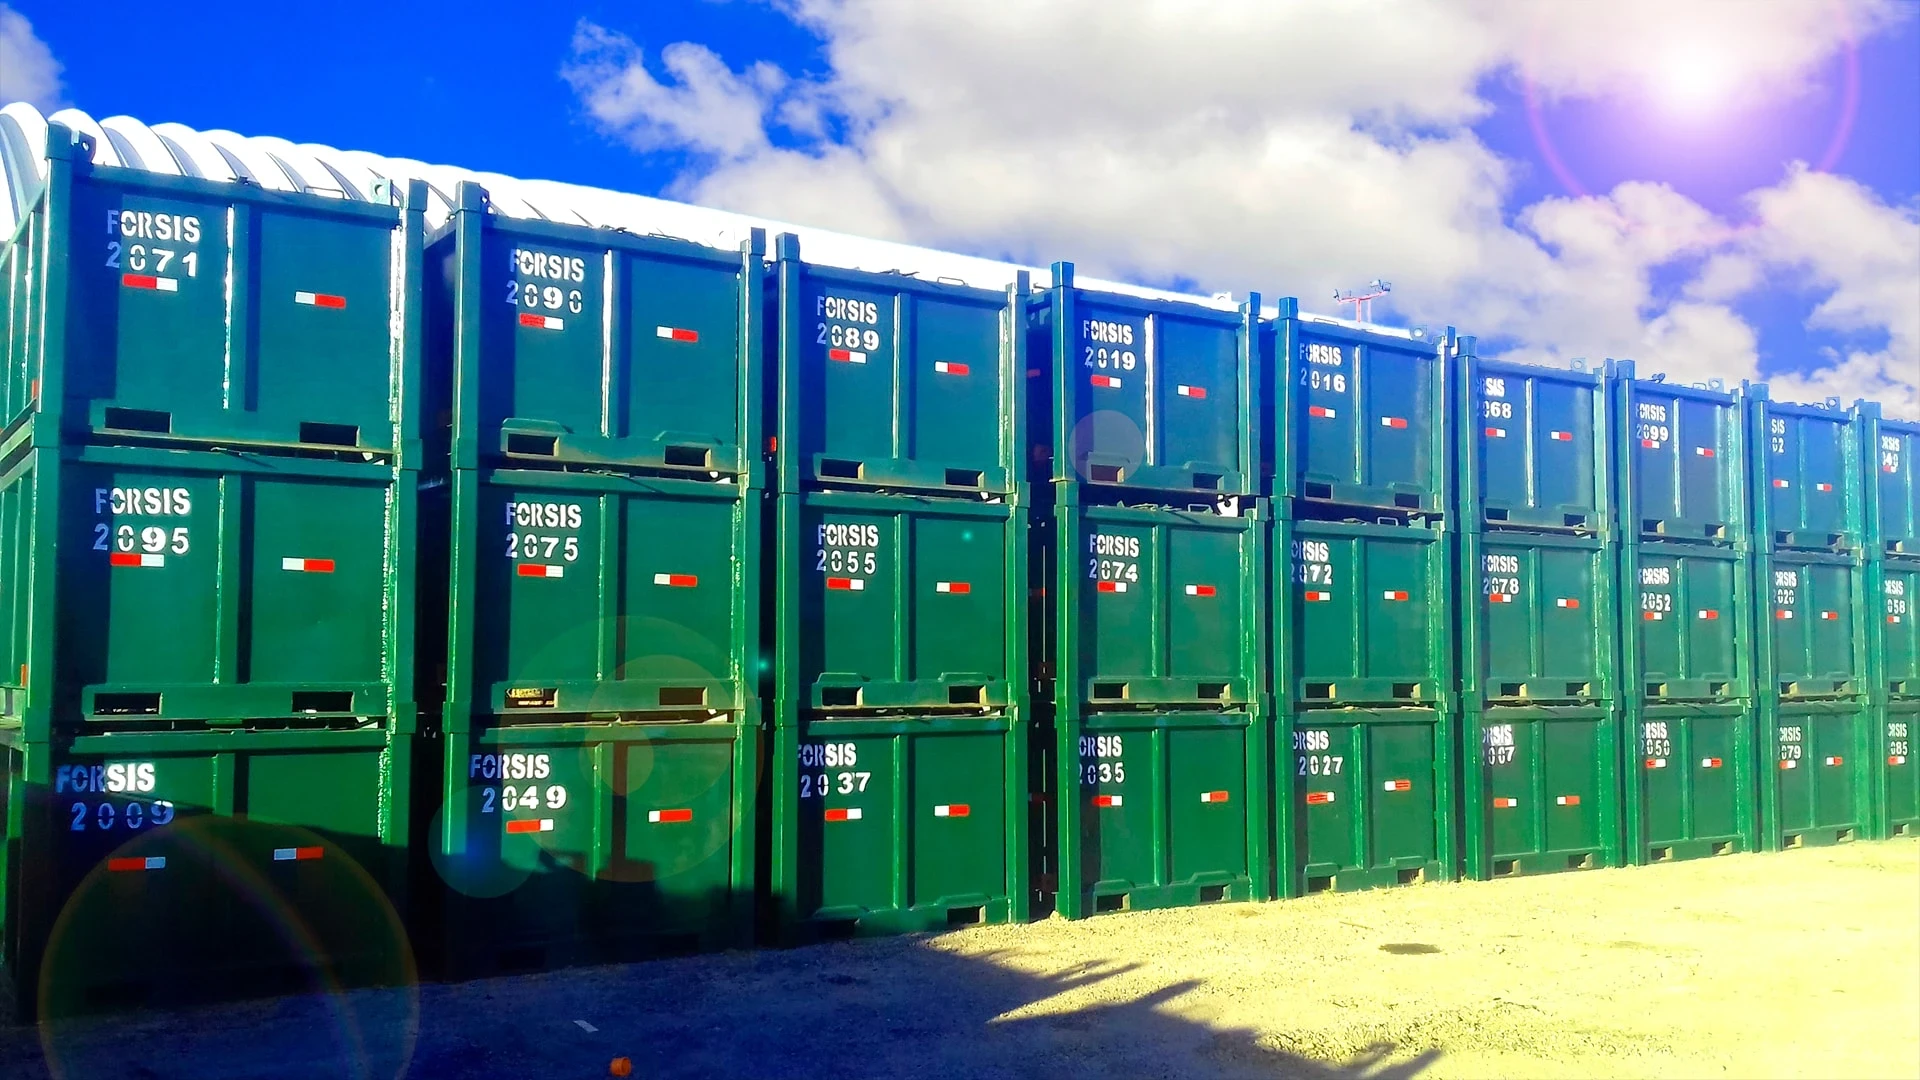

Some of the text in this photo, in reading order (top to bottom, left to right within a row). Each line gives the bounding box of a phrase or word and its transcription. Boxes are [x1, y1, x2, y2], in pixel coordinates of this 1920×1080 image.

[107, 209, 201, 243] FORSIS
[510, 248, 585, 283] FORSIS
[506, 280, 582, 314] 2090
[817, 296, 878, 324] FORSIS
[816, 323, 880, 351] 2089
[1083, 320, 1134, 345] FORSIS
[1084, 346, 1136, 371] 2019
[1299, 343, 1342, 366] FORSIS
[1300, 367, 1346, 392] 2016
[94, 487, 191, 515] FORSIS
[506, 502, 582, 528] FORSIS
[505, 533, 579, 561] 2075
[818, 524, 879, 547] FORSIS
[1090, 534, 1139, 558] FORSIS
[816, 549, 876, 575] 2055
[1089, 558, 1139, 583] 2074
[1482, 554, 1519, 573] FORSIS
[1483, 577, 1519, 595] 2078
[1641, 592, 1671, 611] 2052
[56, 763, 156, 793] FORSIS
[470, 754, 550, 780] FORSIS
[1299, 755, 1343, 775] 2027
[801, 771, 871, 798] 2037
[482, 785, 567, 813] 2049
[71, 800, 175, 831] 2009
